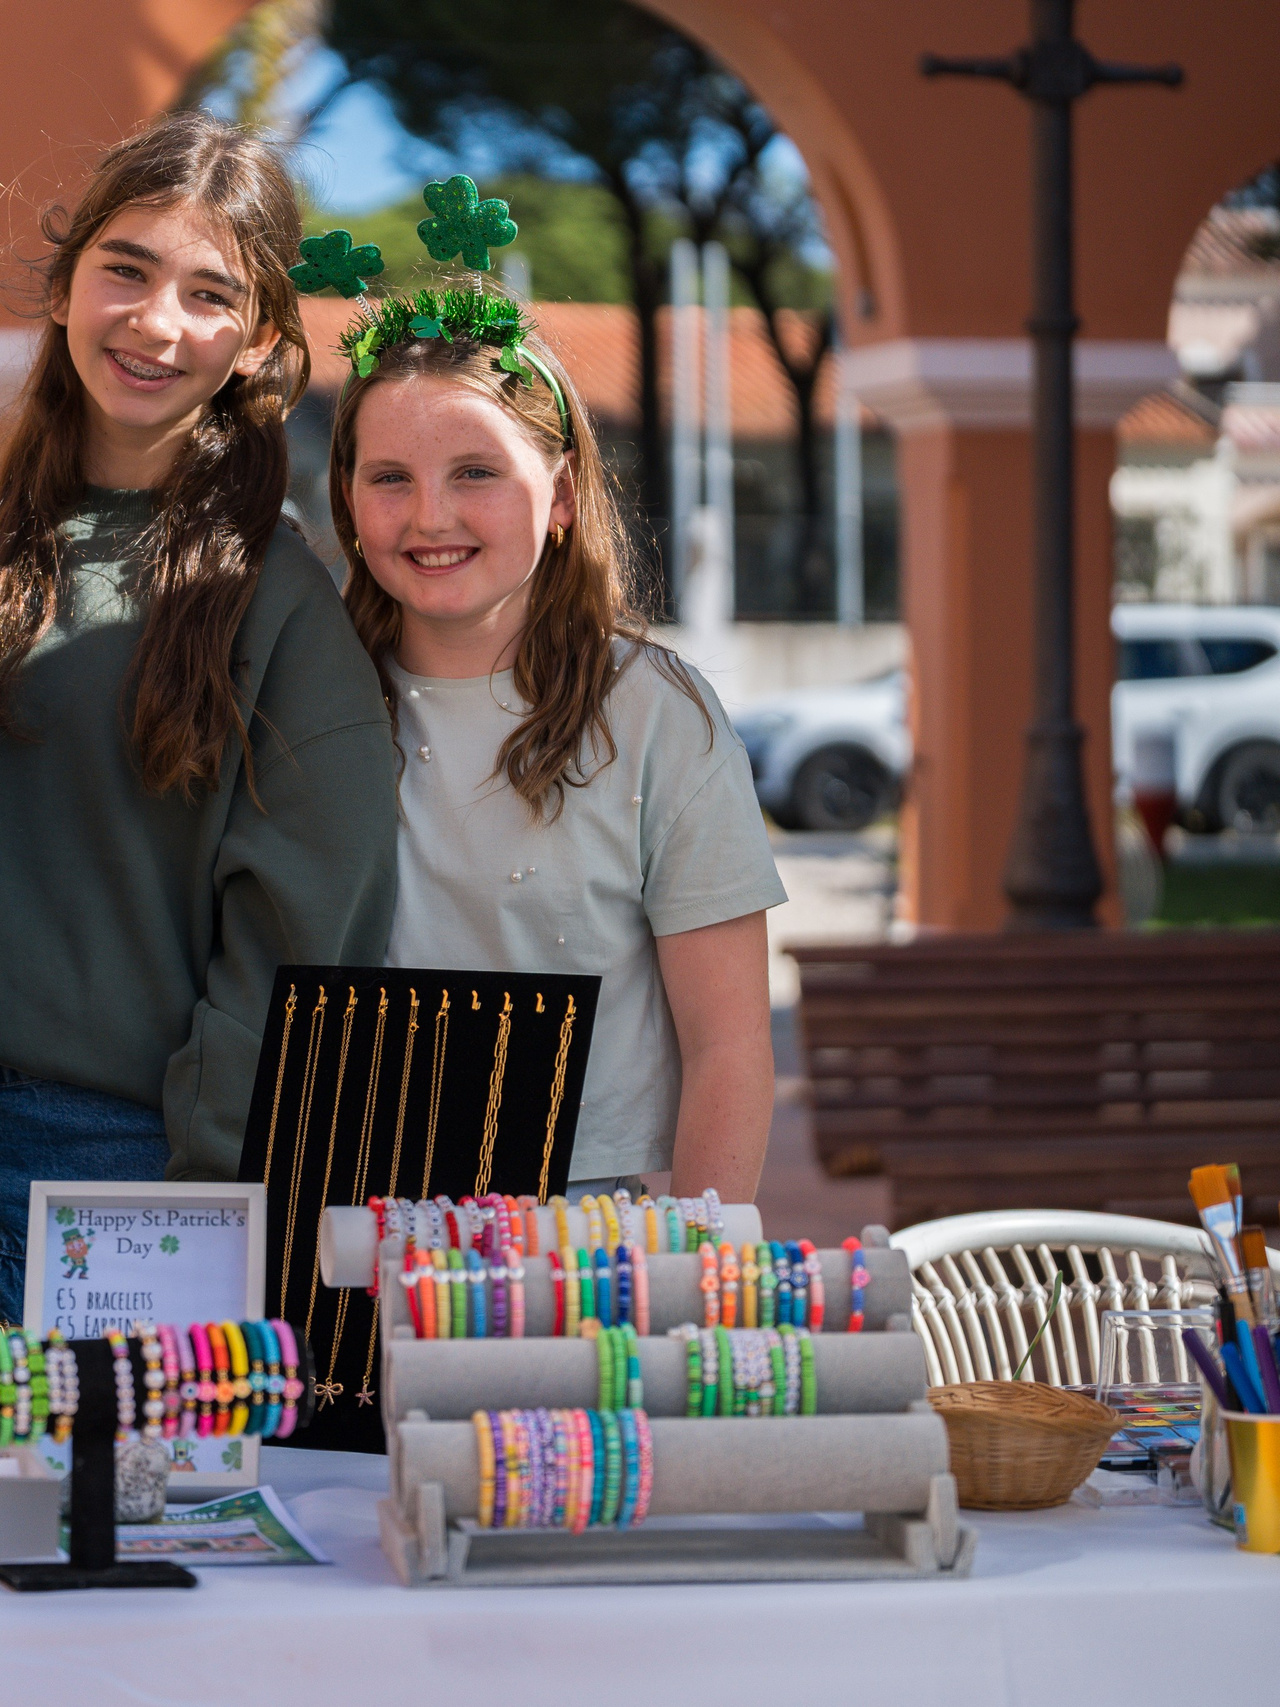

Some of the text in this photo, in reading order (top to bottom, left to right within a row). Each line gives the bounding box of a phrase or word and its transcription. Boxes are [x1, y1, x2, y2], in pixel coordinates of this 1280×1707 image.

[78, 1209, 137, 1232] Happy
[117, 1237, 153, 1259] Day
[56, 1287, 153, 1311] €5 BRACELETS
[84, 1315, 154, 1338] EARIN
